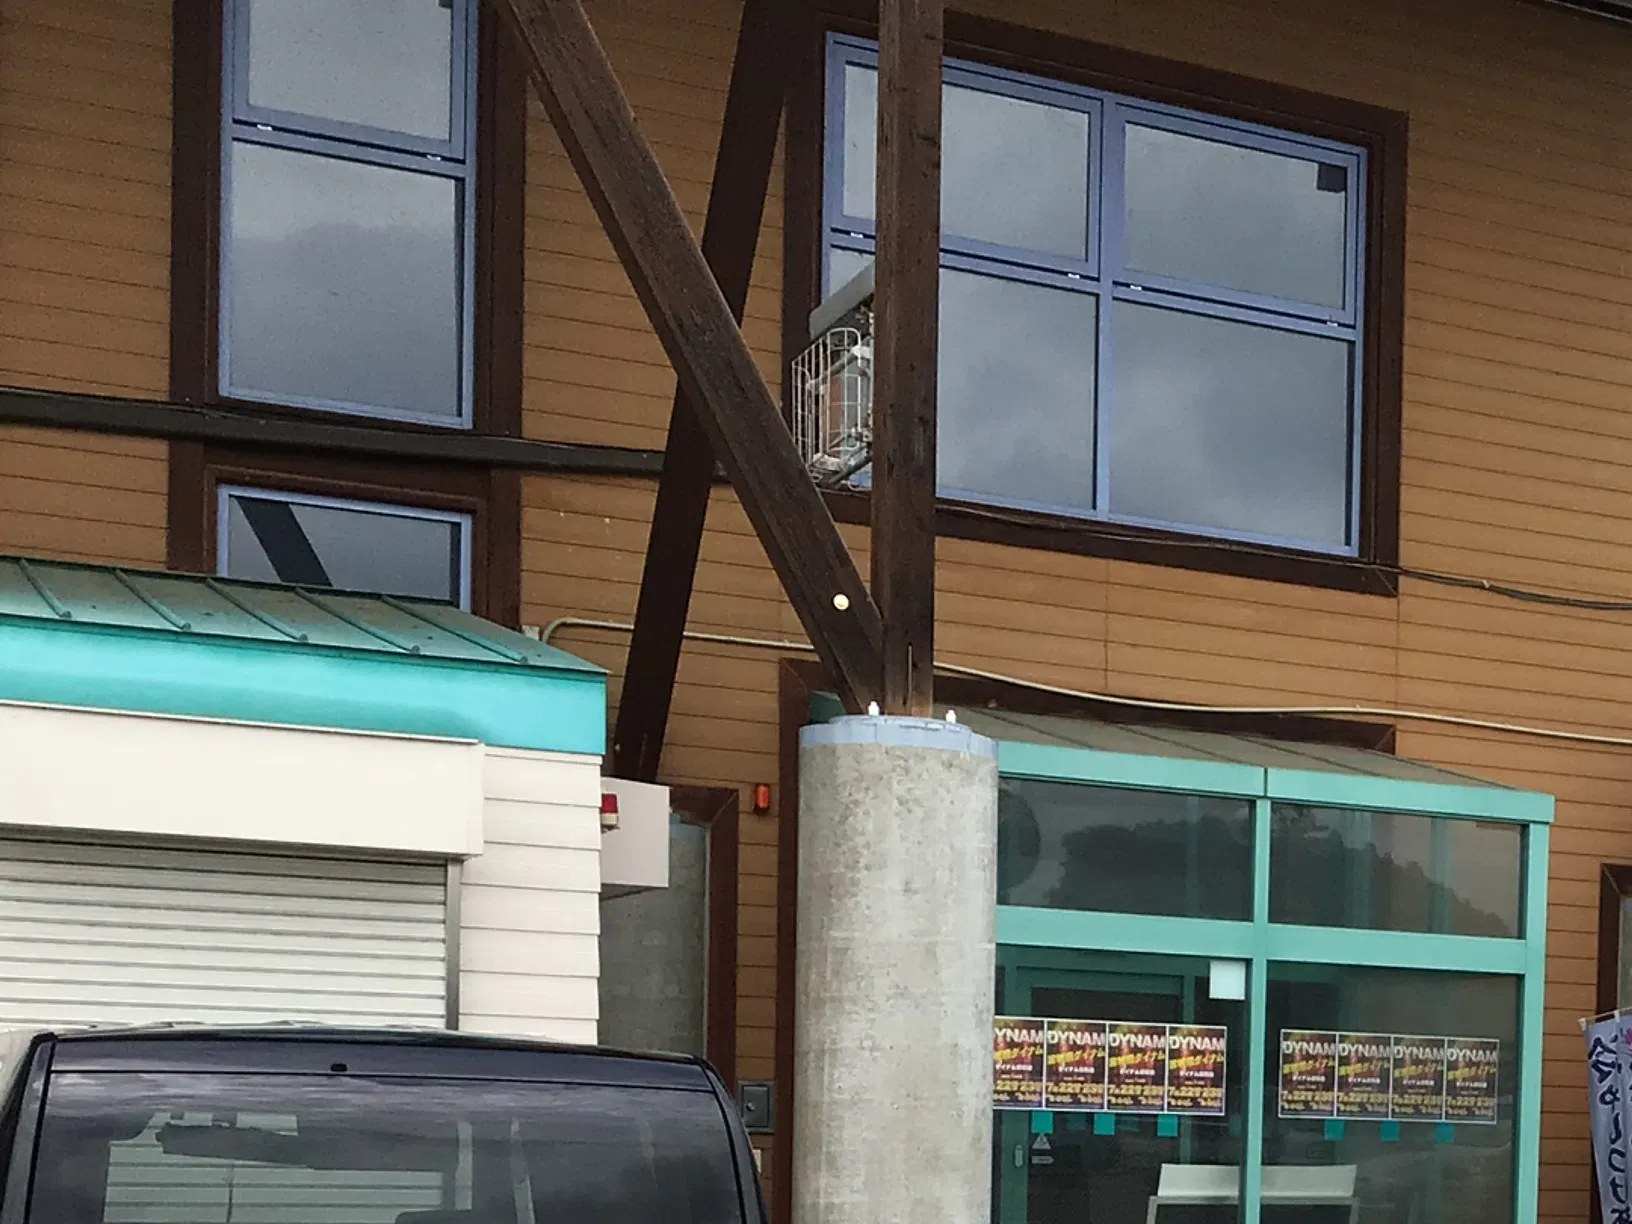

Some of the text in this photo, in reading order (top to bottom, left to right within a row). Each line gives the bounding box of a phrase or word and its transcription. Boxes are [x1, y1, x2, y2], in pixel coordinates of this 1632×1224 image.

[1047, 1030, 1105, 1047] DYNAM
[1108, 1033, 1165, 1049] DYNAM
[1169, 1035, 1224, 1051] DYNAM
